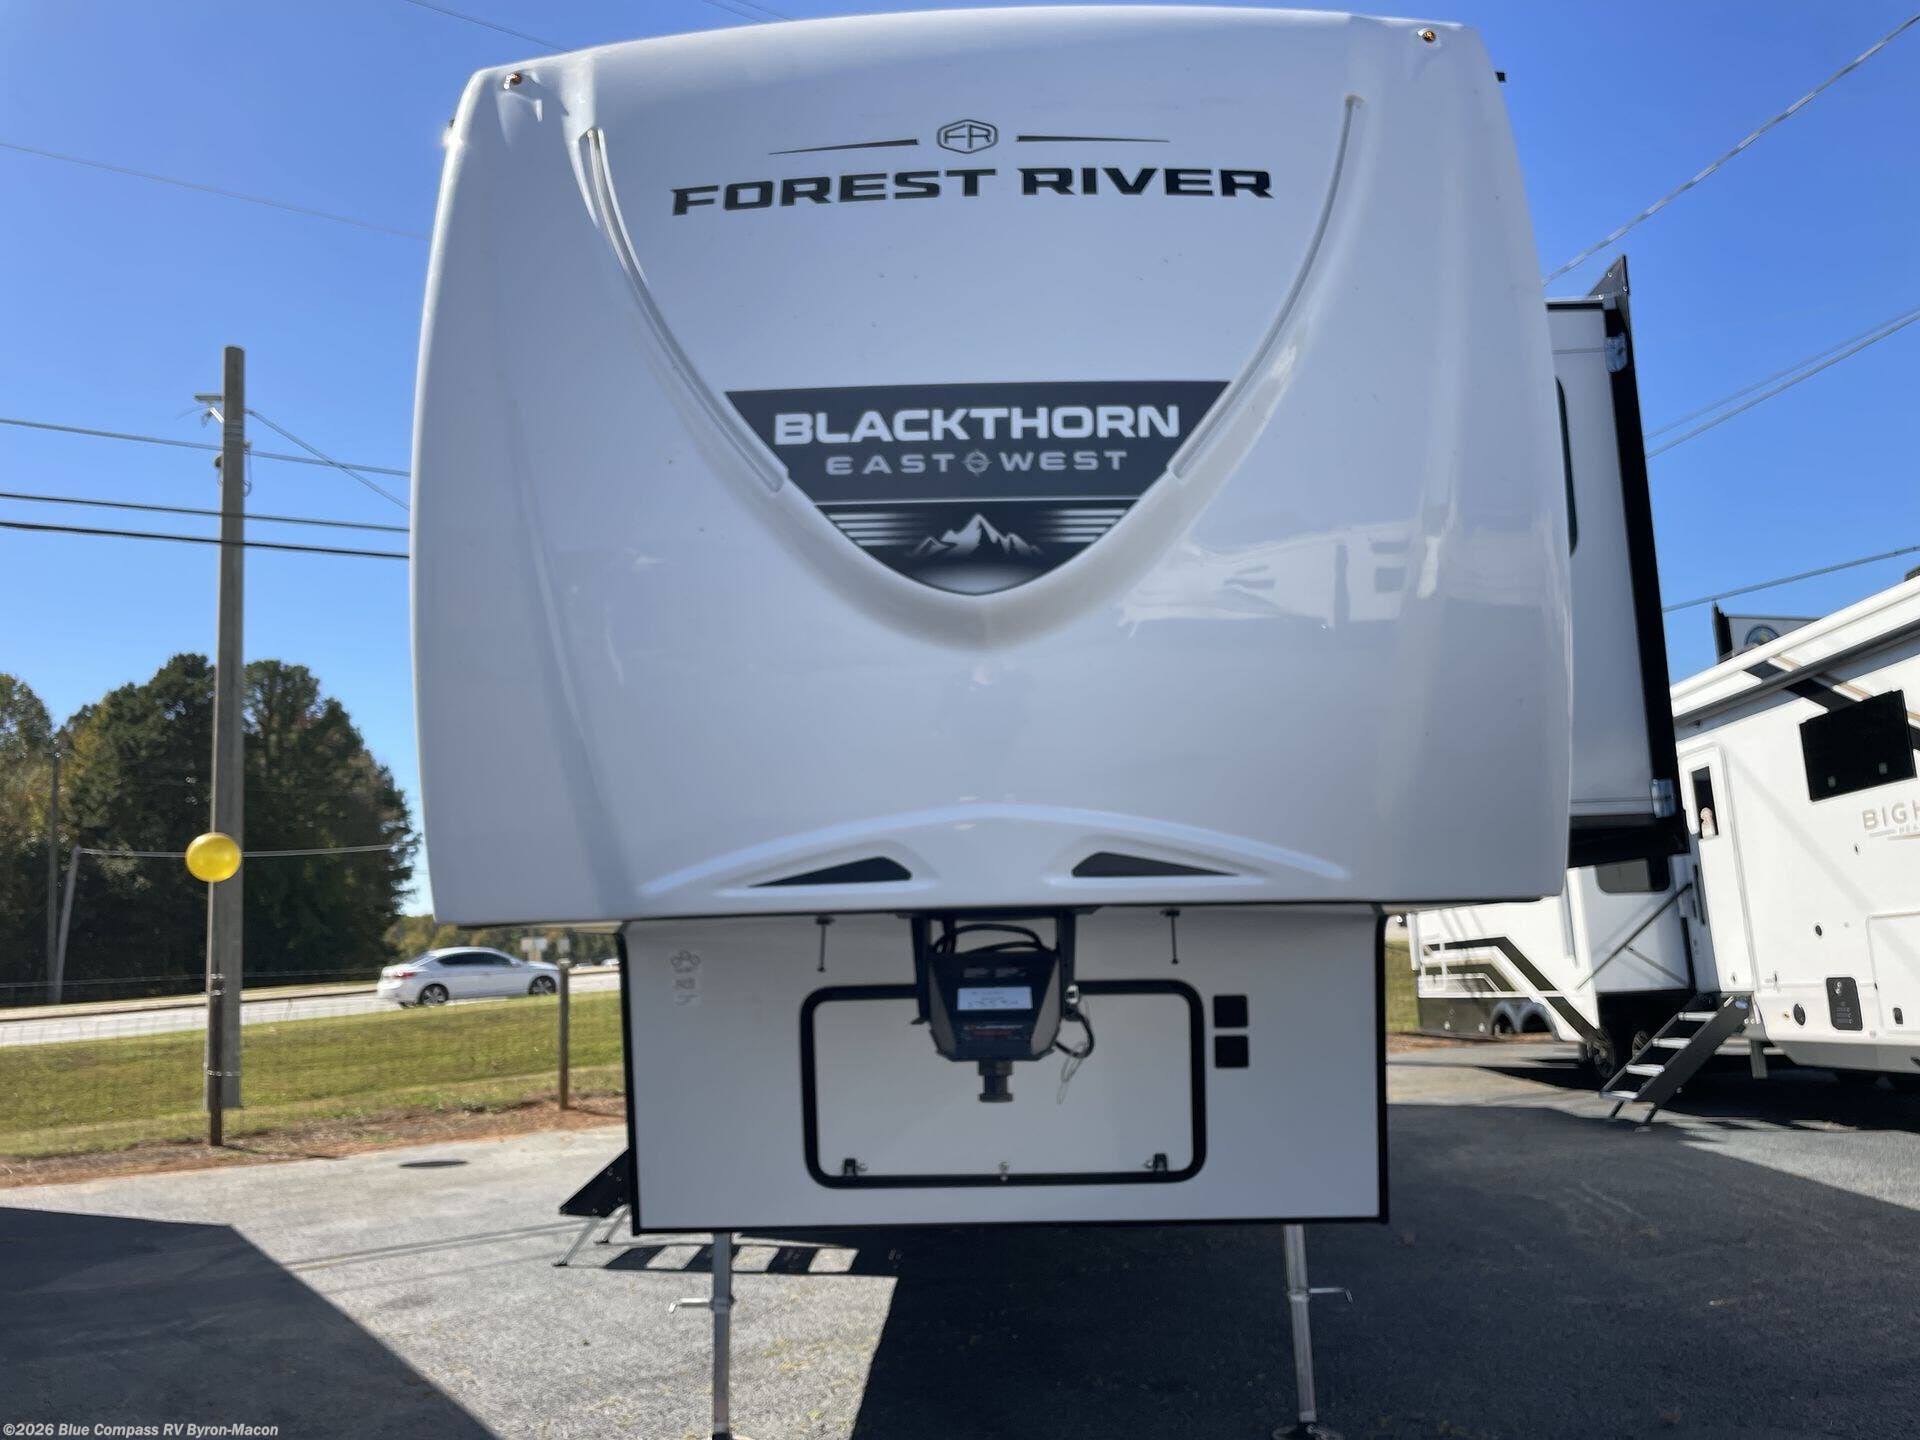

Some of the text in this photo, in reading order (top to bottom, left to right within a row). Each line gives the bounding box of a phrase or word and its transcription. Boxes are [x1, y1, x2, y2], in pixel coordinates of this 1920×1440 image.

[671, 167, 1274, 216] FOREST RIVER
[774, 405, 1180, 445] BLACKTHORN
[826, 450, 1128, 475] EAST WEST
